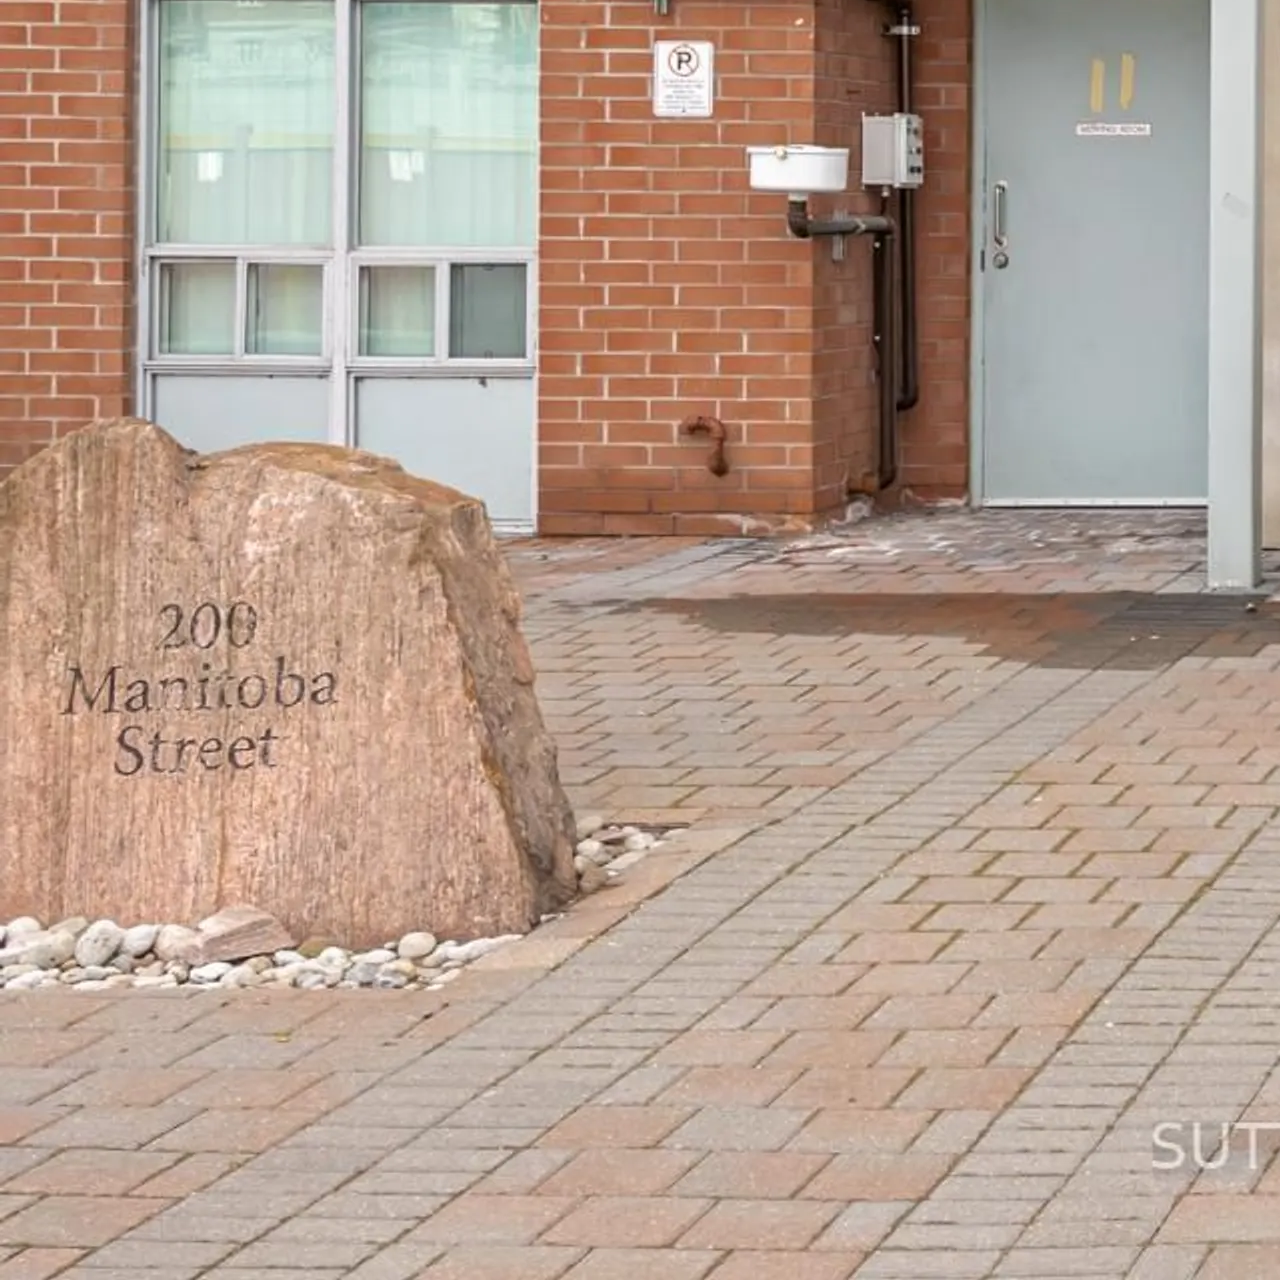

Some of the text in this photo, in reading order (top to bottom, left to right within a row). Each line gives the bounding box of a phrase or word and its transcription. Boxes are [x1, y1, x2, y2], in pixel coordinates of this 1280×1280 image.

[154, 600, 258, 652] 200
[61, 655, 339, 715] Manitoba
[113, 725, 283, 777] Street
